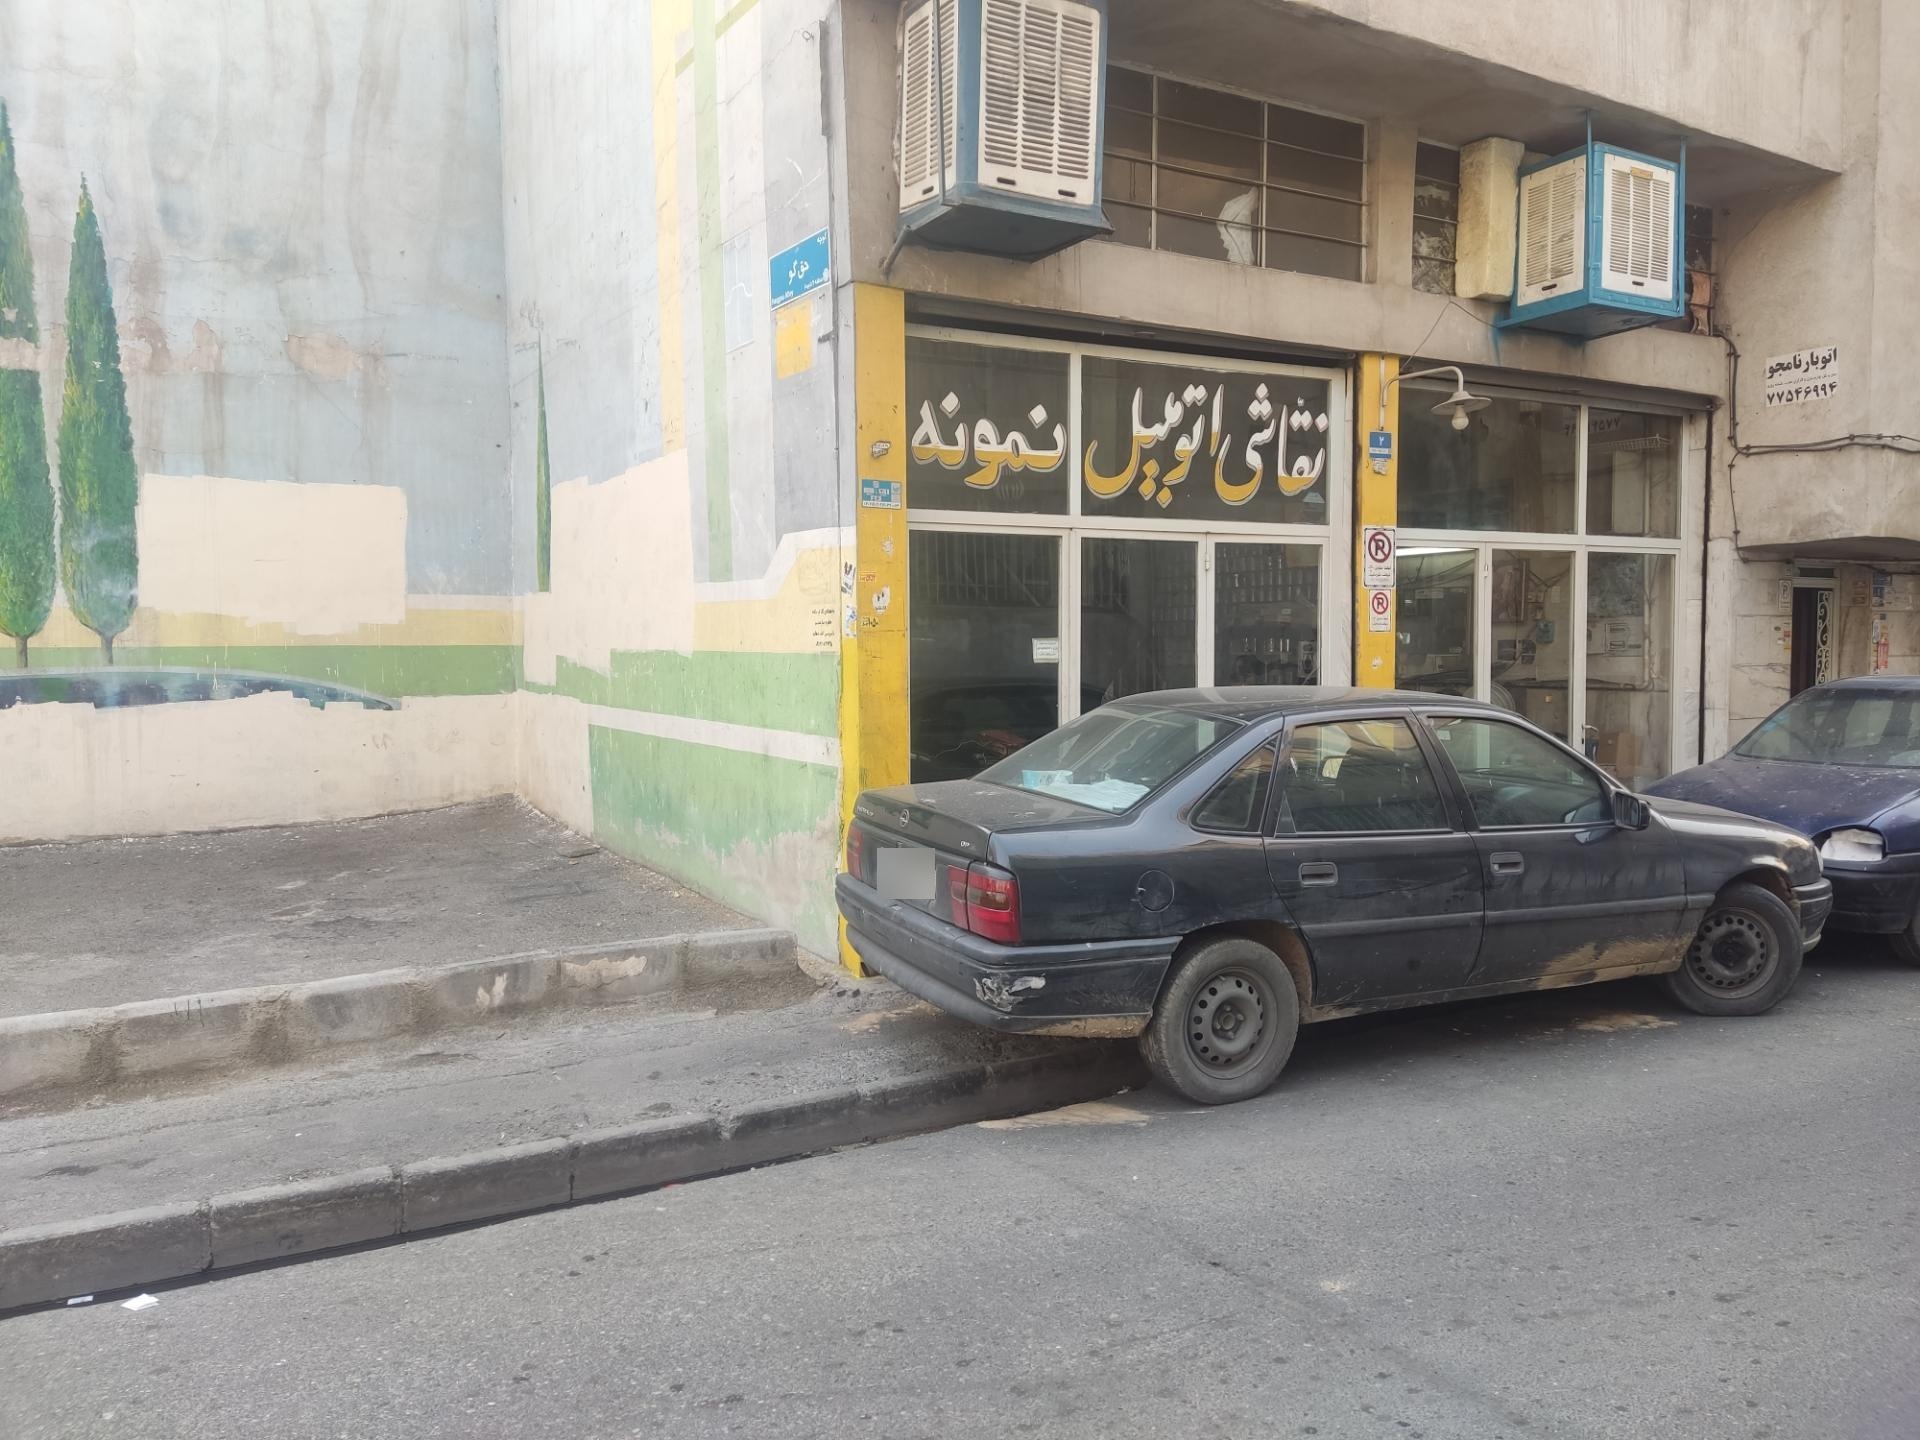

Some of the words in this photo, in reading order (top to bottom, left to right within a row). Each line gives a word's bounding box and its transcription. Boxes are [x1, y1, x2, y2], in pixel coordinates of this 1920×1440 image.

[1767, 354, 1802, 379] نامجو
[1803, 347, 1837, 372] اتوبار
[1767, 381, 1837, 405] ۷۷۵۴۶۹۹۴
[911, 391, 1067, 489] نمونه
[1084, 383, 1225, 508] اتومبیل
[1214, 383, 1330, 505] نقاشی
